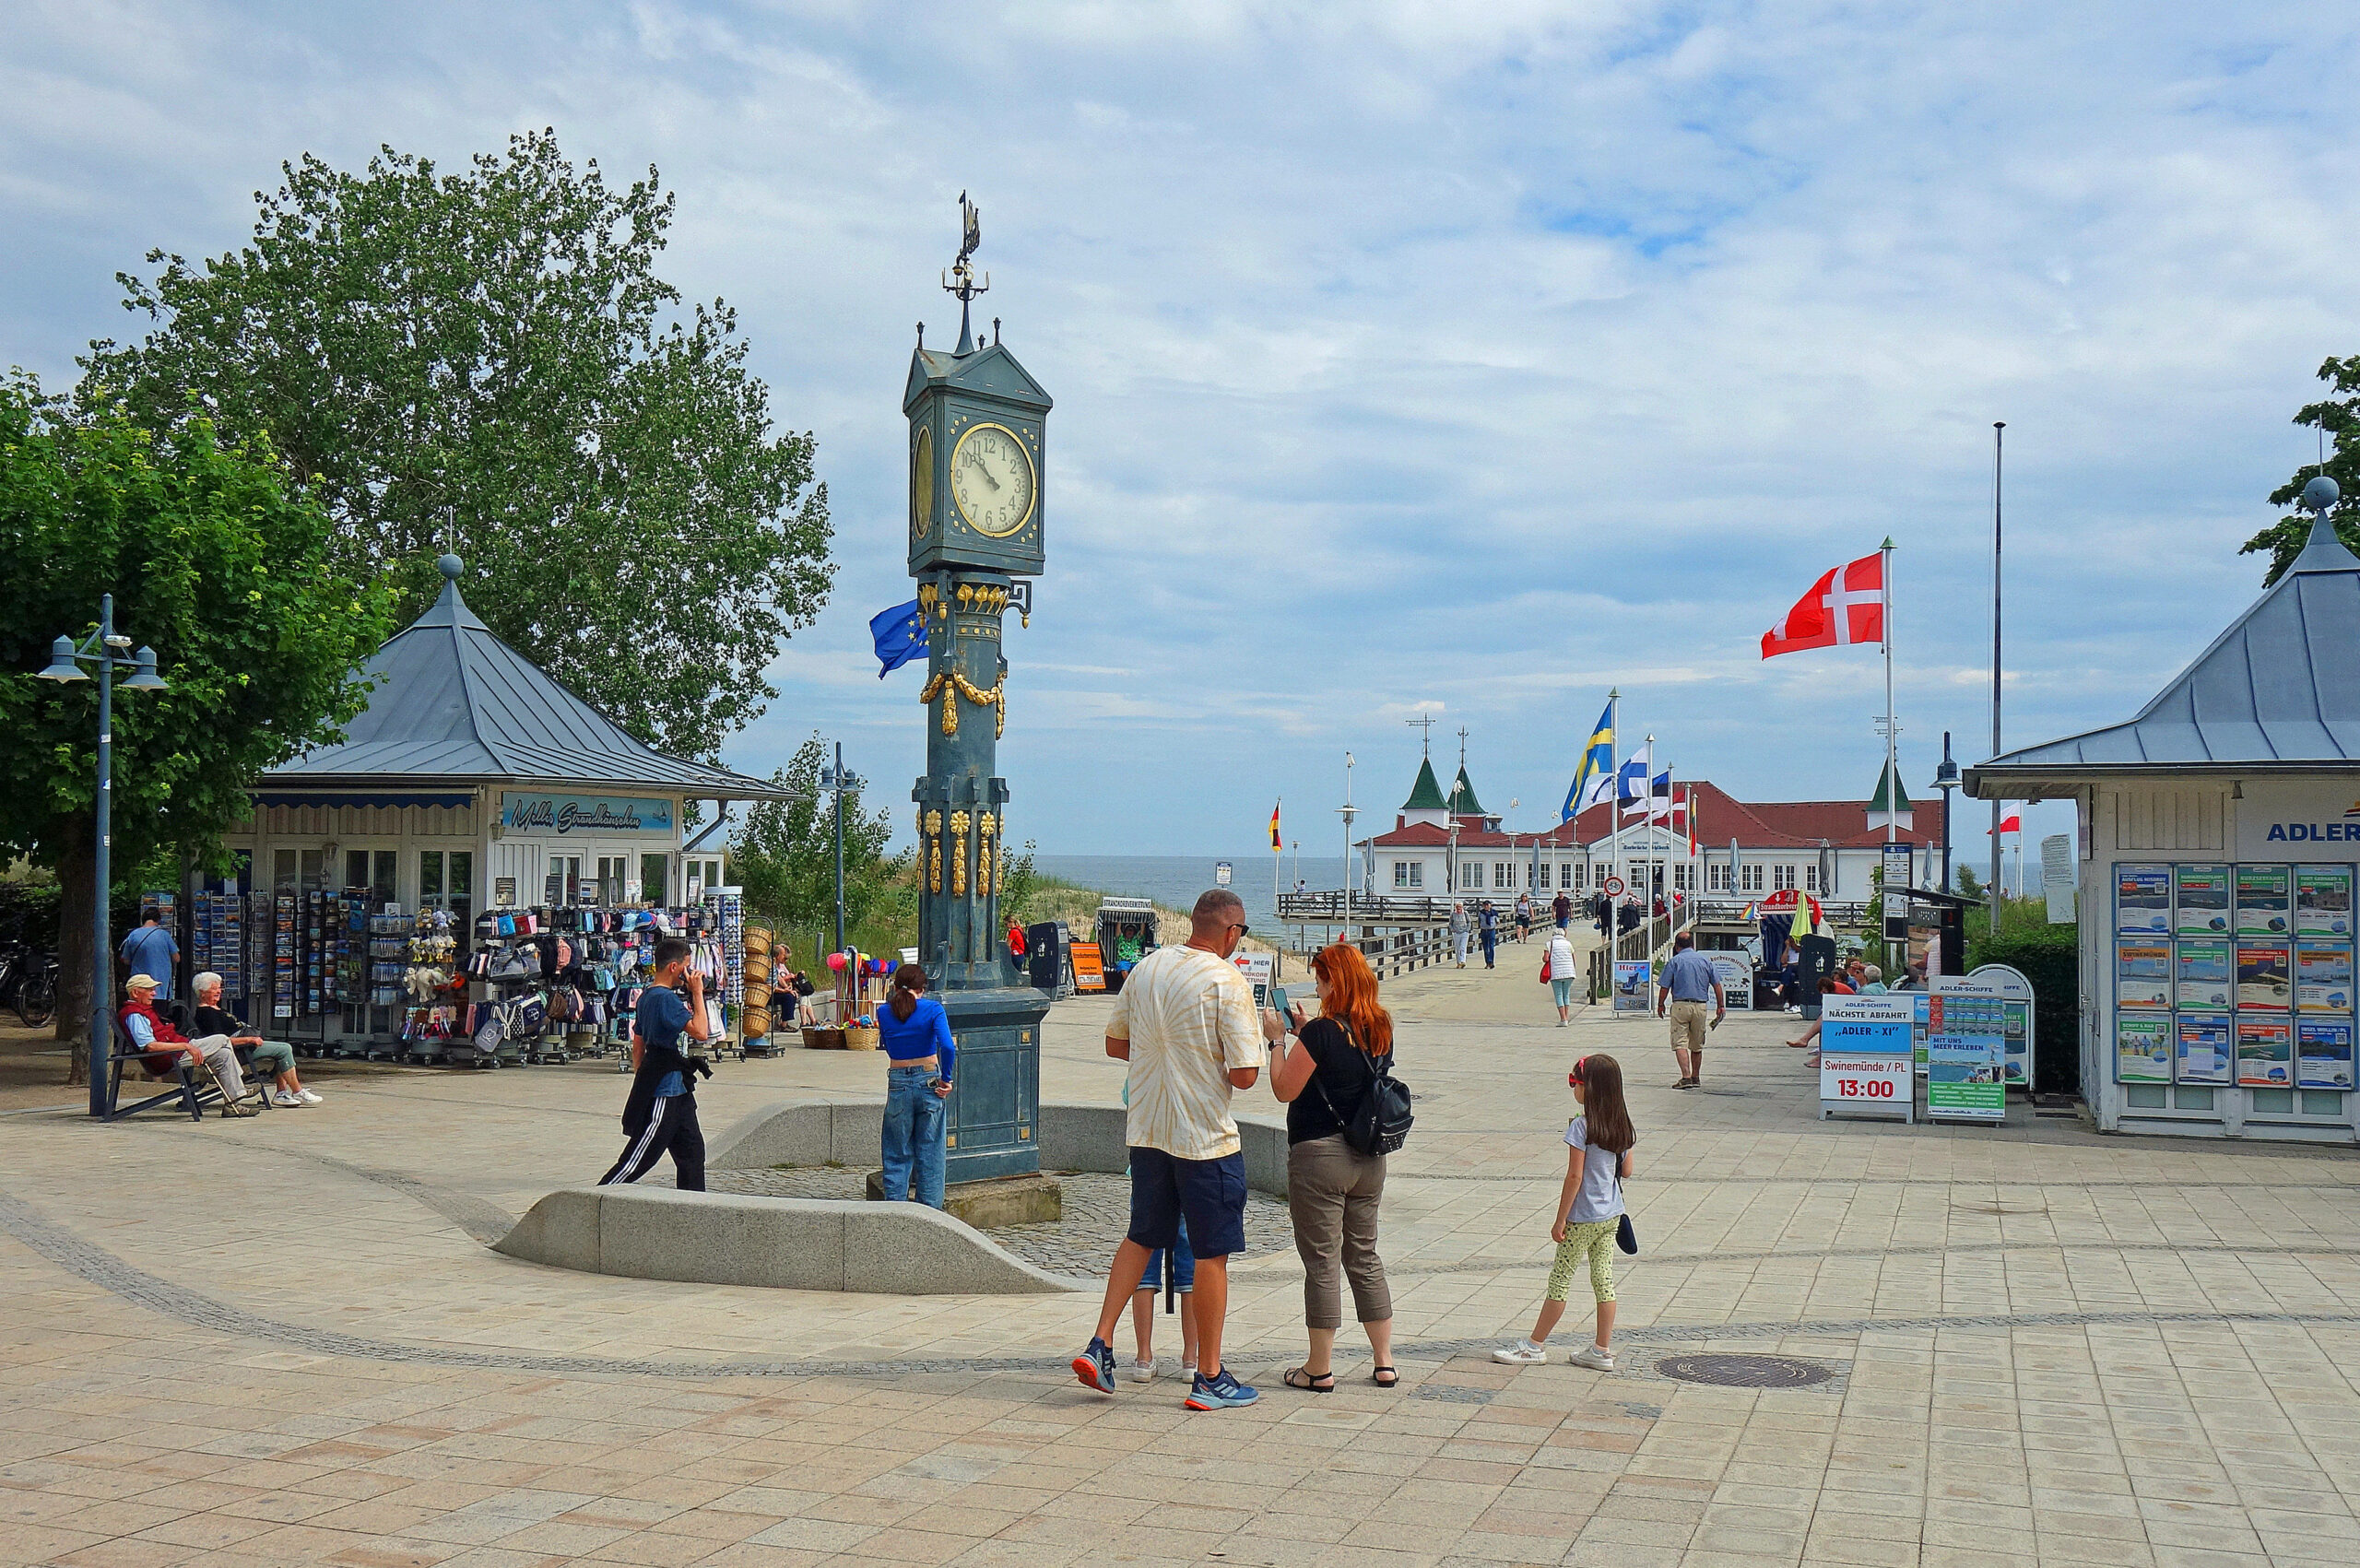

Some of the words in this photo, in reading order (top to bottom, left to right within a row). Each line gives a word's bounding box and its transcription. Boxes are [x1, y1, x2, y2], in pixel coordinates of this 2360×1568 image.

[973, 441, 981, 455] 11
[984, 438, 996, 454] 12
[1001, 446, 1007, 461] 1
[961, 452, 973, 468] 10
[1009, 459, 1017, 474] 2
[956, 469, 963, 484] 9
[1014, 478, 1021, 493] 3
[961, 489, 968, 504] 8
[1008, 496, 1015, 510] 4
[972, 504, 978, 519] 7
[985, 511, 993, 525] 6
[999, 507, 1006, 522] 5
[2267, 823, 2360, 842] ADLER
[1829, 1008, 1866, 1019] NÄCHSTE
[1825, 1060, 1884, 1072] Swinemünde
[1894, 1062, 1906, 1073] PL
[1837, 1079, 1894, 1098] 13:00
